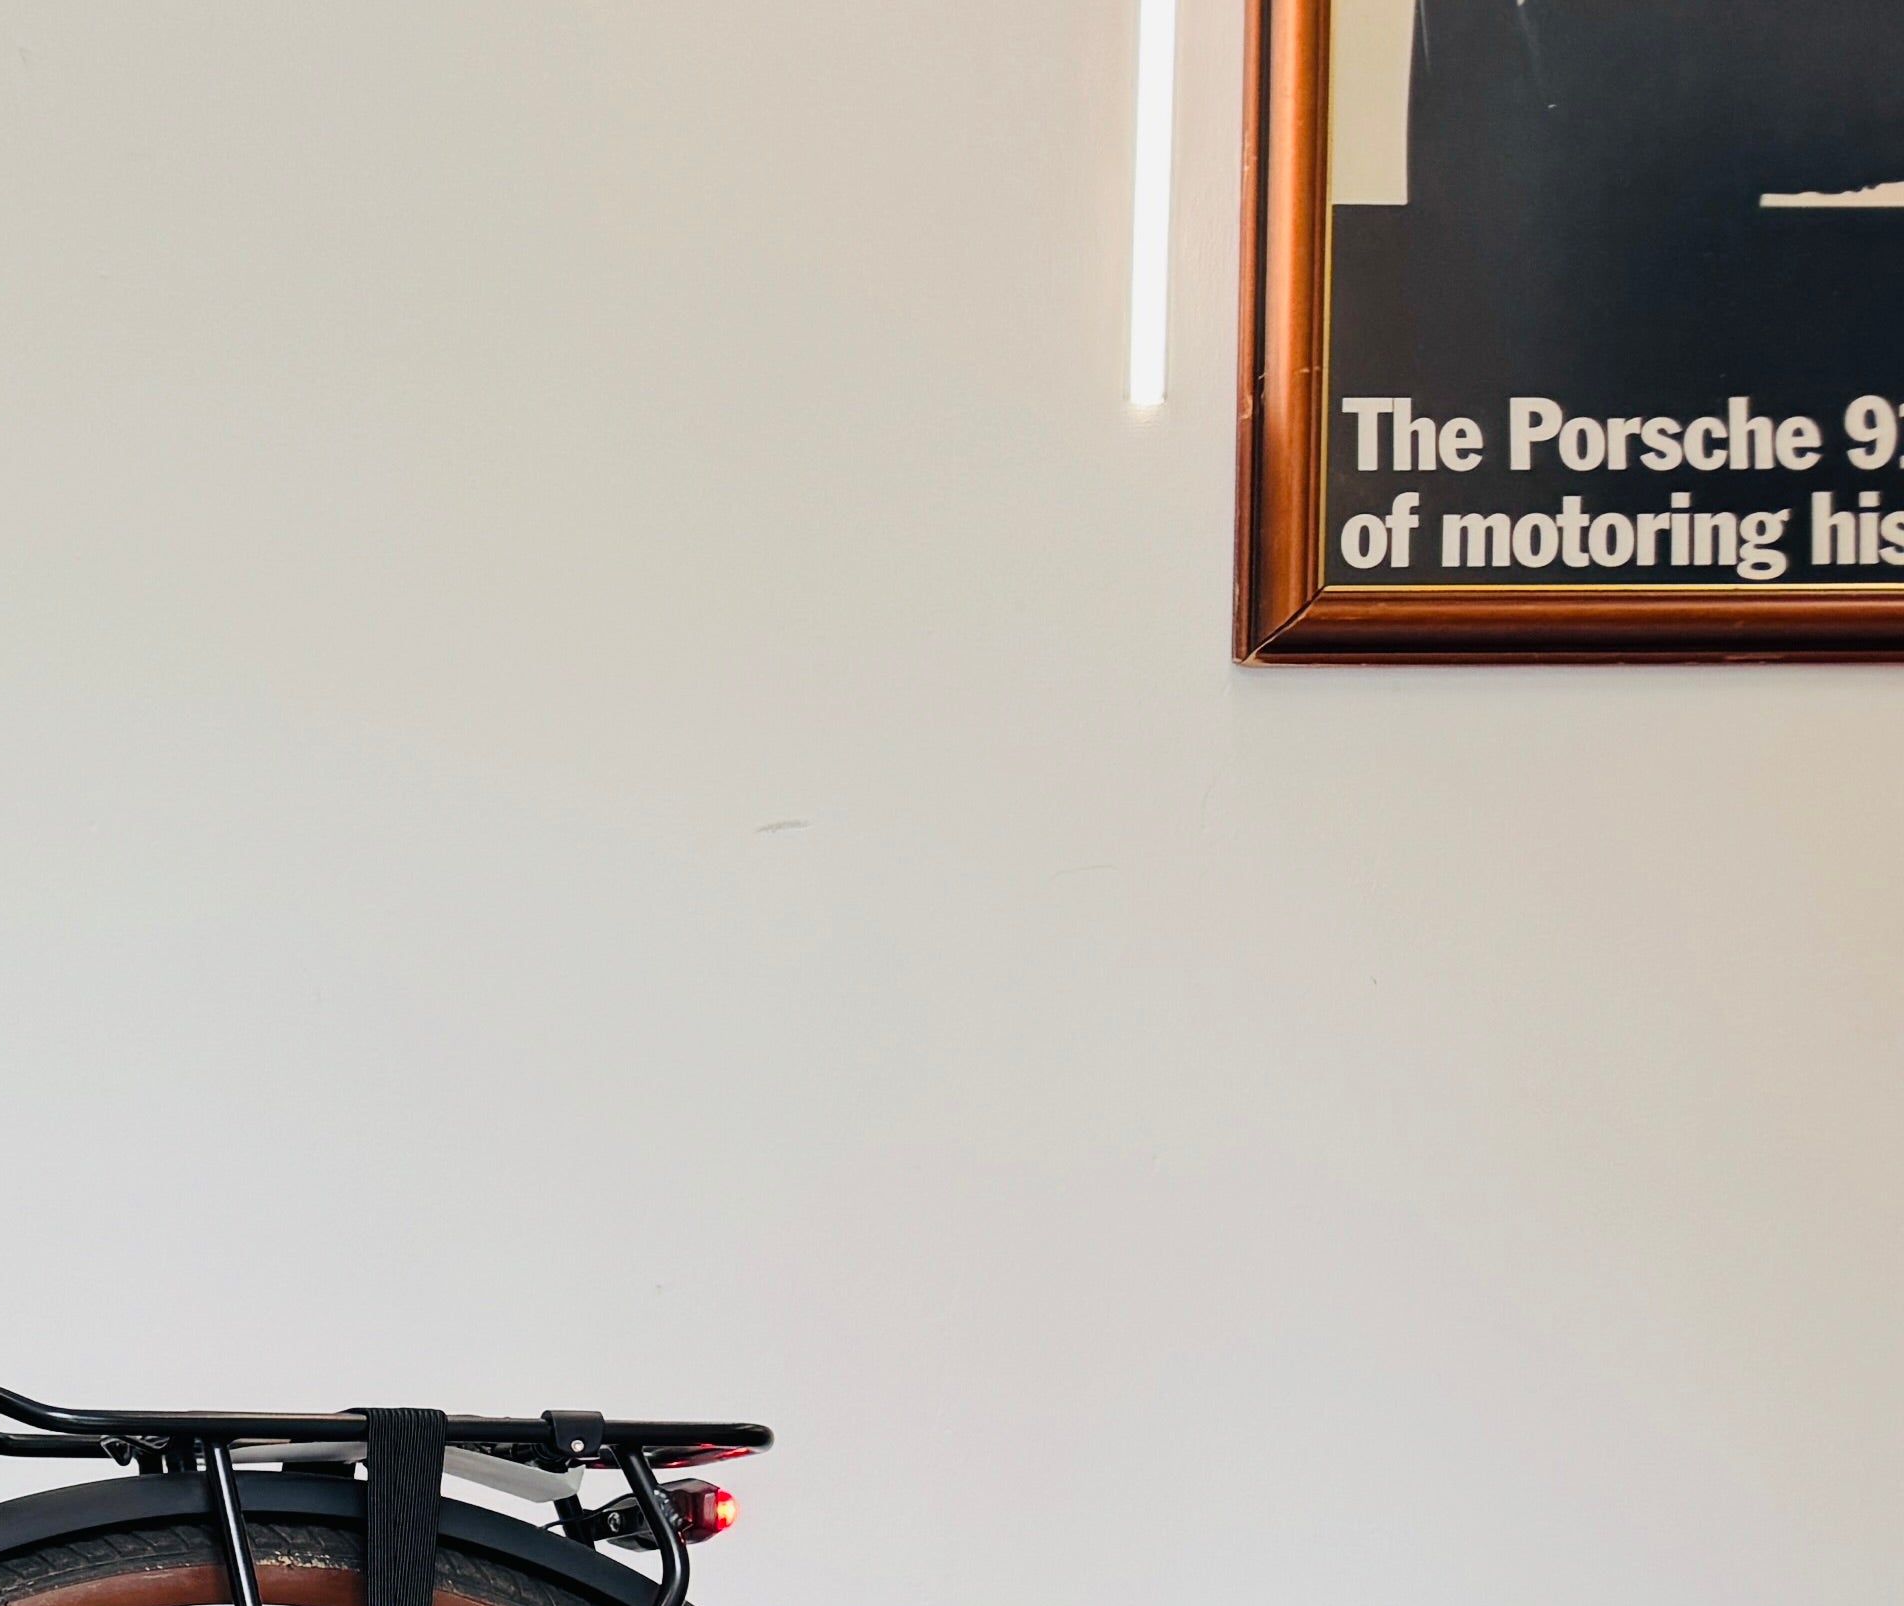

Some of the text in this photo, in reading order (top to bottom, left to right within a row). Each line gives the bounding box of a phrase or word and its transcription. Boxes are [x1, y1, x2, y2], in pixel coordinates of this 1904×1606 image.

[1341, 395, 1904, 471] The Porsche 9
[1340, 492, 1420, 570] of
[1441, 491, 1790, 580] motoring
